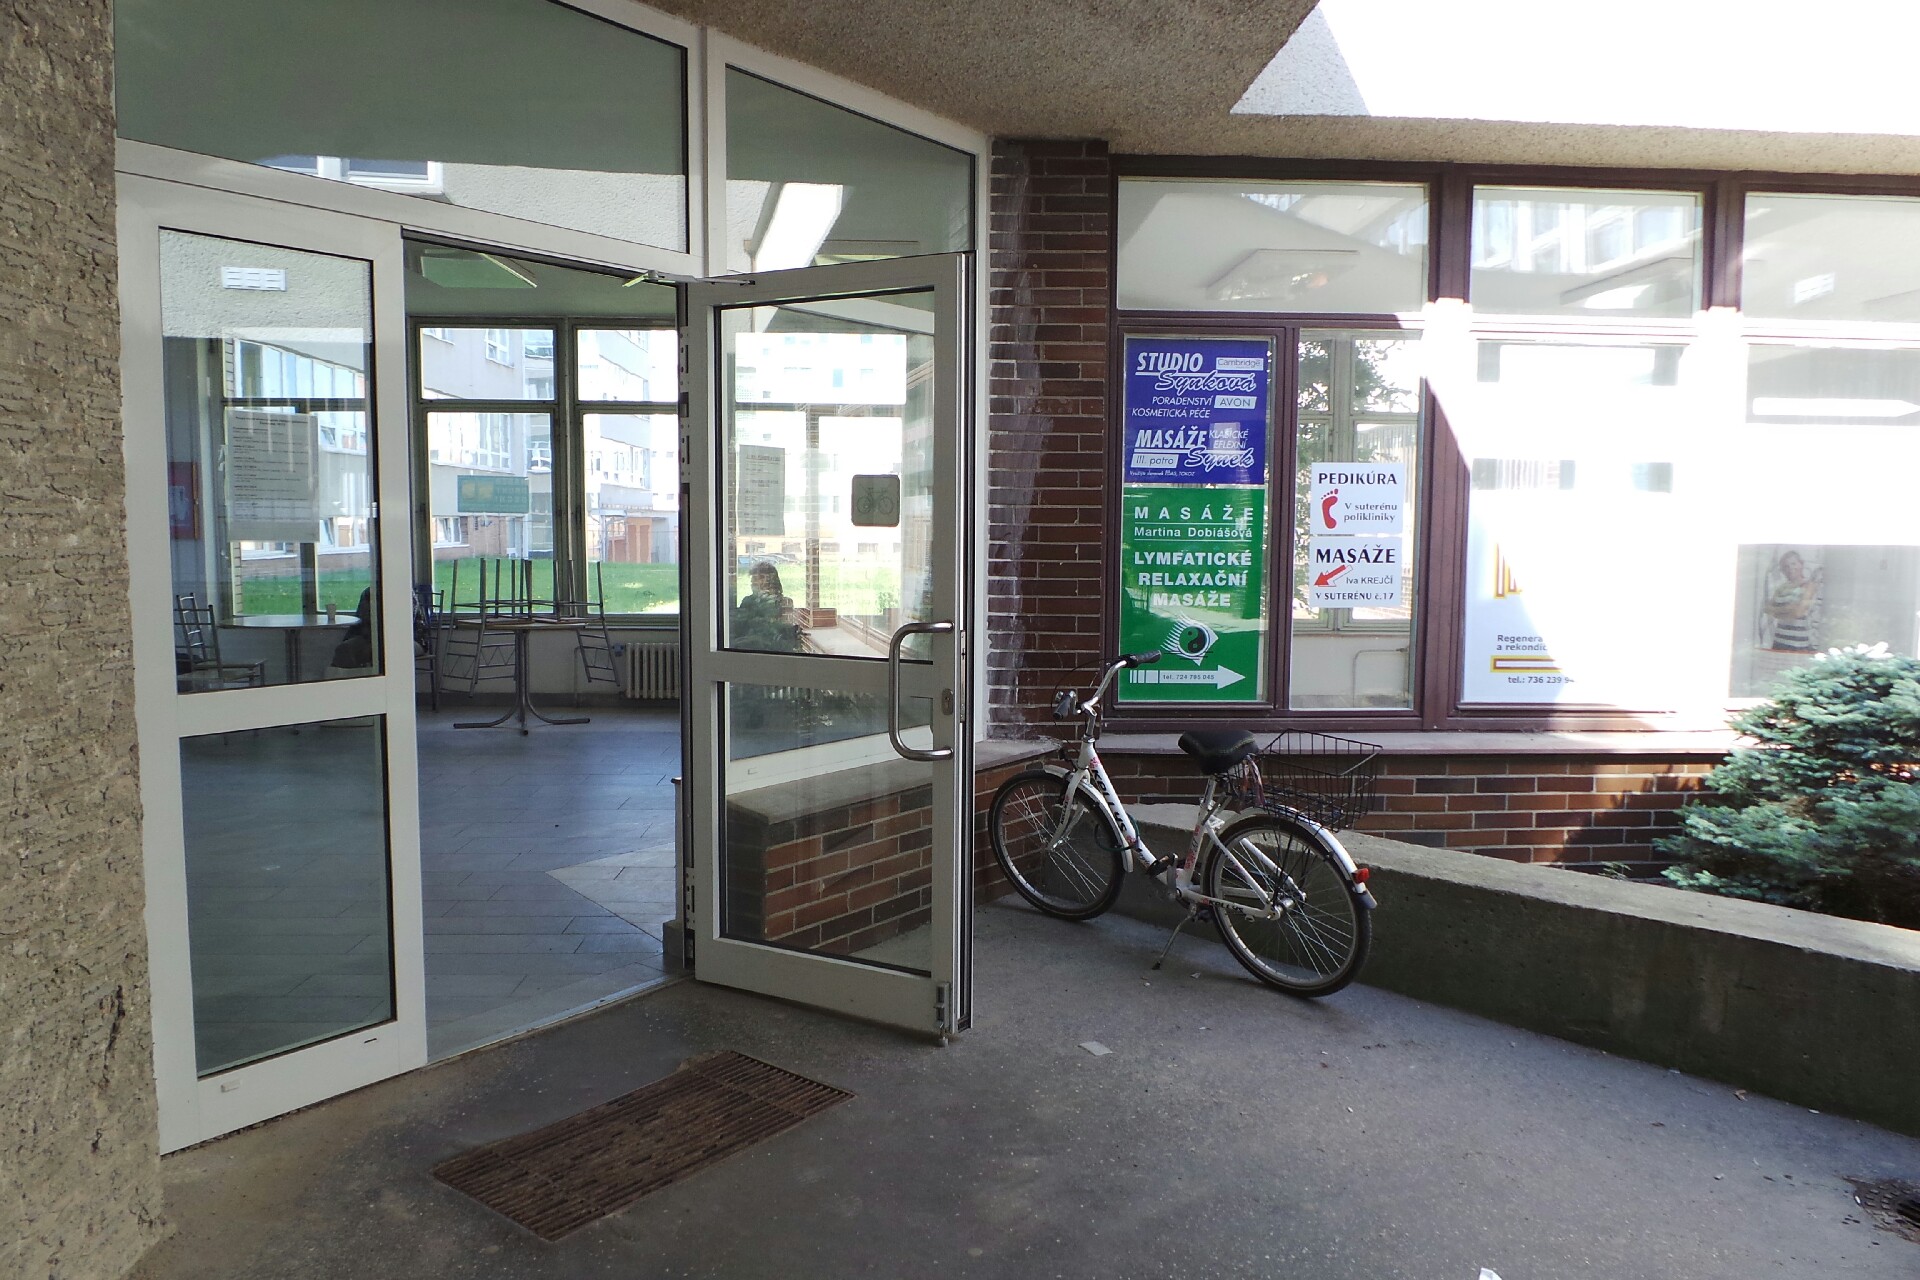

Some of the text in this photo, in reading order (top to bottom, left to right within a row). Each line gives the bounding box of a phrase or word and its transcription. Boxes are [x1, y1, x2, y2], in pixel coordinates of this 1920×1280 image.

[1137, 352, 1203, 372] STUDIO
[1155, 370, 1256, 395] Synková
[1152, 395, 1251, 407] PORADENSTVÍ AVON
[1132, 406, 1211, 419] KOSMETICKÁ PÉČE
[1135, 425, 1207, 449] MASÁŽE
[1209, 428, 1250, 439] KLASICKÉ
[1150, 456, 1174, 465] patro
[1184, 446, 1255, 472] Synek
[1318, 471, 1397, 485] PEDIKÚRA
[1354, 502, 1398, 511] suterénu
[1344, 512, 1396, 523] polikliniky
[1134, 527, 1253, 538] Martina Dobiášová
[1134, 549, 1252, 566] LYMFATICKÉ
[1316, 544, 1396, 563] MASÁŽE
[1138, 570, 1248, 586] RELAXAČNÍ
[1361, 575, 1393, 584] KREJČÍ
[1153, 590, 1231, 607] MASÁŽE
[1324, 590, 1372, 600] SUTERÉNU
